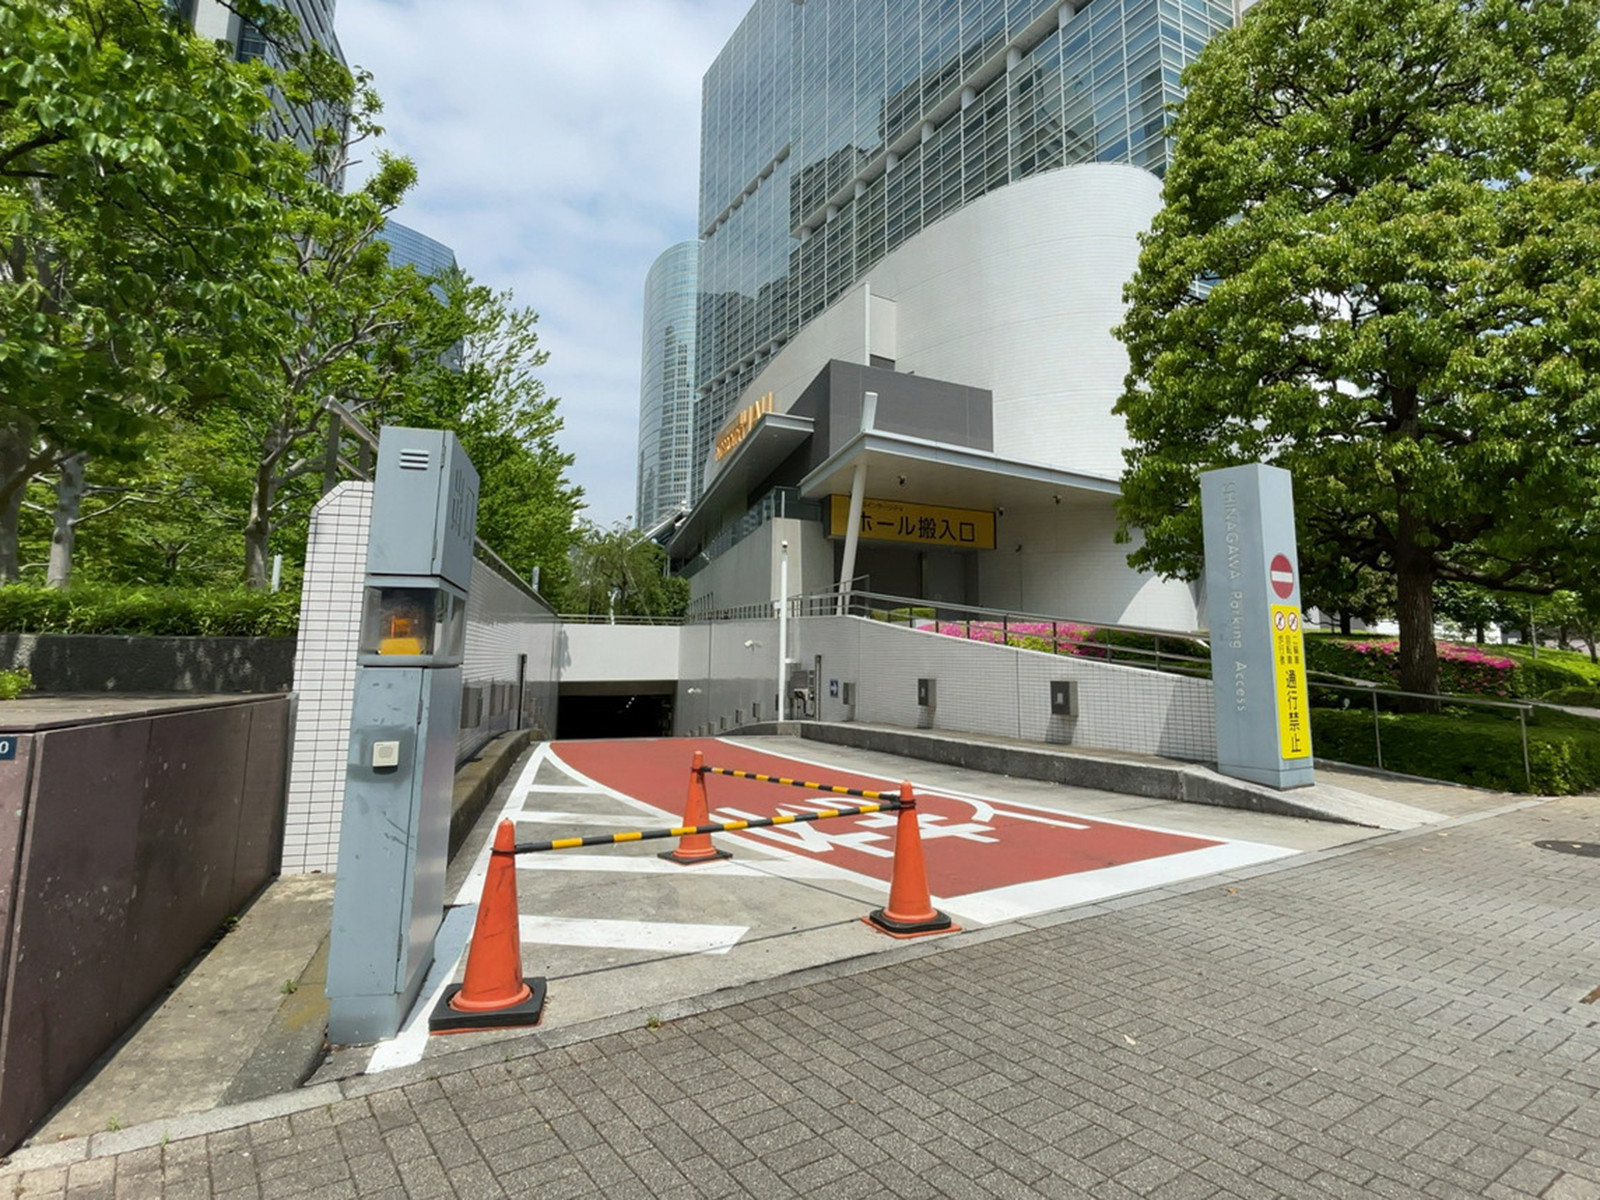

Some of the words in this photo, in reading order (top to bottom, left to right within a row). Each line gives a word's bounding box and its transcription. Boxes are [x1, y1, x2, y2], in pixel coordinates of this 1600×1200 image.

[861, 511, 975, 542] ホール搬入口
[1223, 482, 1241, 580] SHINAGAWA
[1229, 591, 1243, 649] Parking
[1235, 661, 1248, 711] Access
[1285, 669, 1302, 753] 通行禁止
